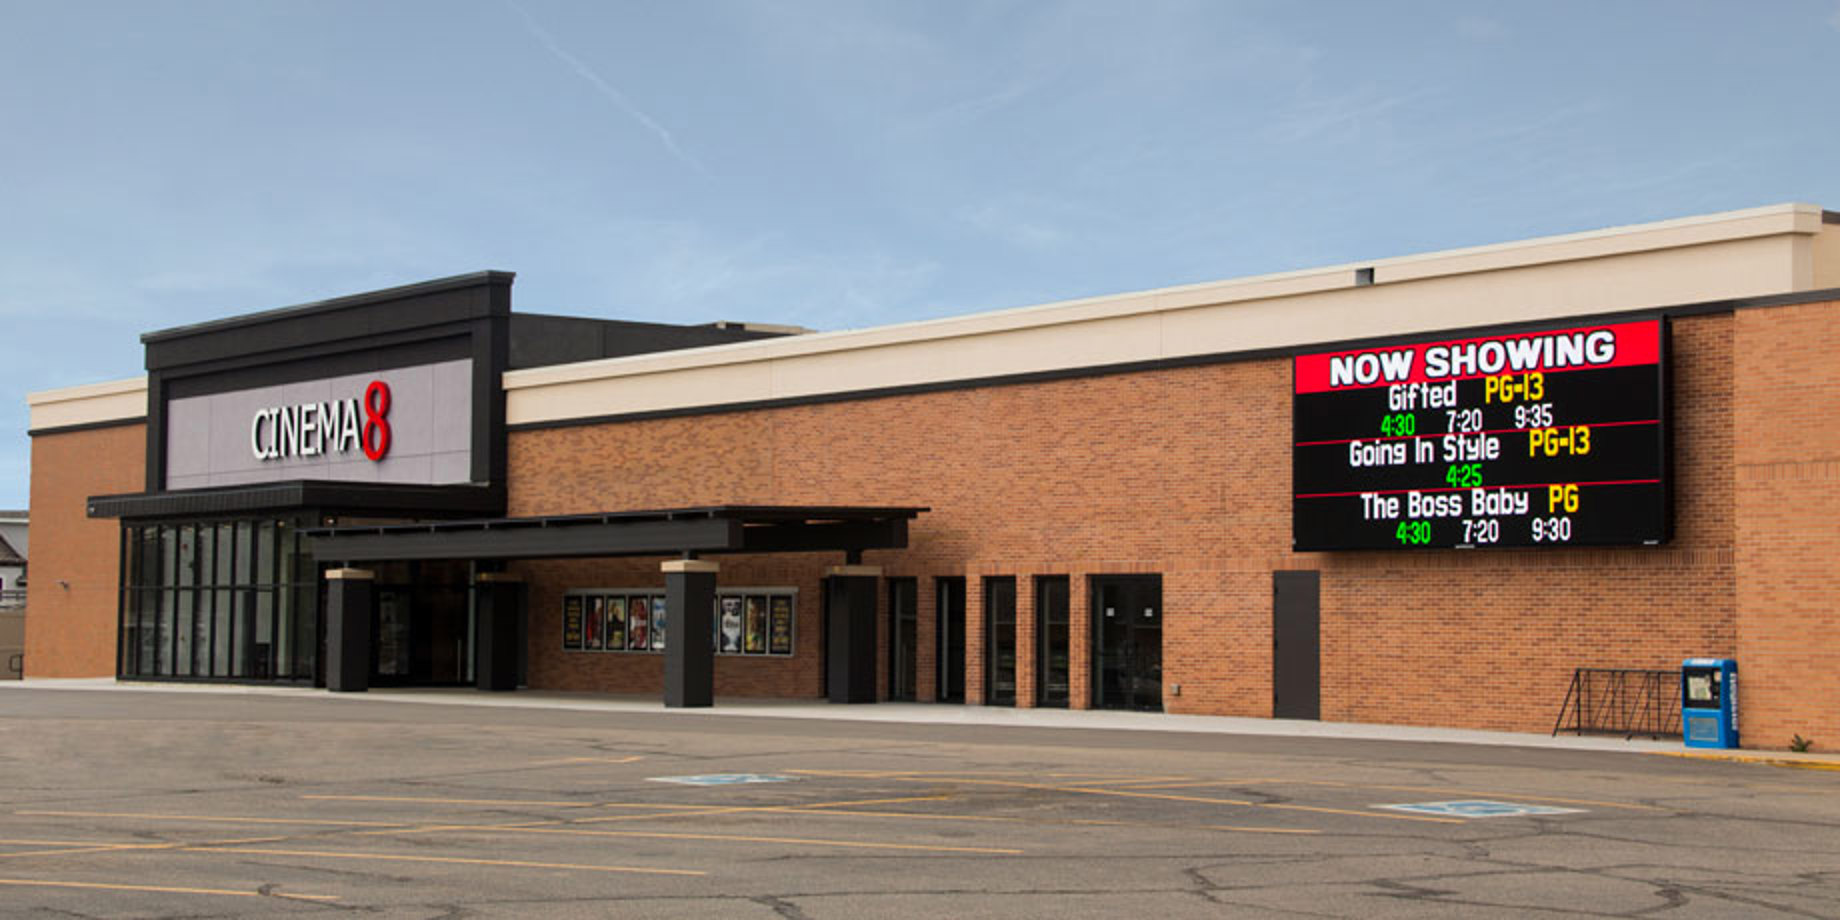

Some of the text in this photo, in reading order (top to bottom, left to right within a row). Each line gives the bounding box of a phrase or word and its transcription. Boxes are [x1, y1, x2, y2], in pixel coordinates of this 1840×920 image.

[1330, 330, 1615, 386] NOW SHOWING
[1388, 372, 1544, 411] Gifted PG-13
[1381, 403, 1552, 436] 4:30 7:20 9:35
[1349, 425, 1590, 467] Going In Style PG-13
[1446, 464, 1483, 488] 4:25
[1361, 484, 1579, 519] The Boss Baby PG
[1396, 517, 1571, 544] 4:30 7:20 9:30
